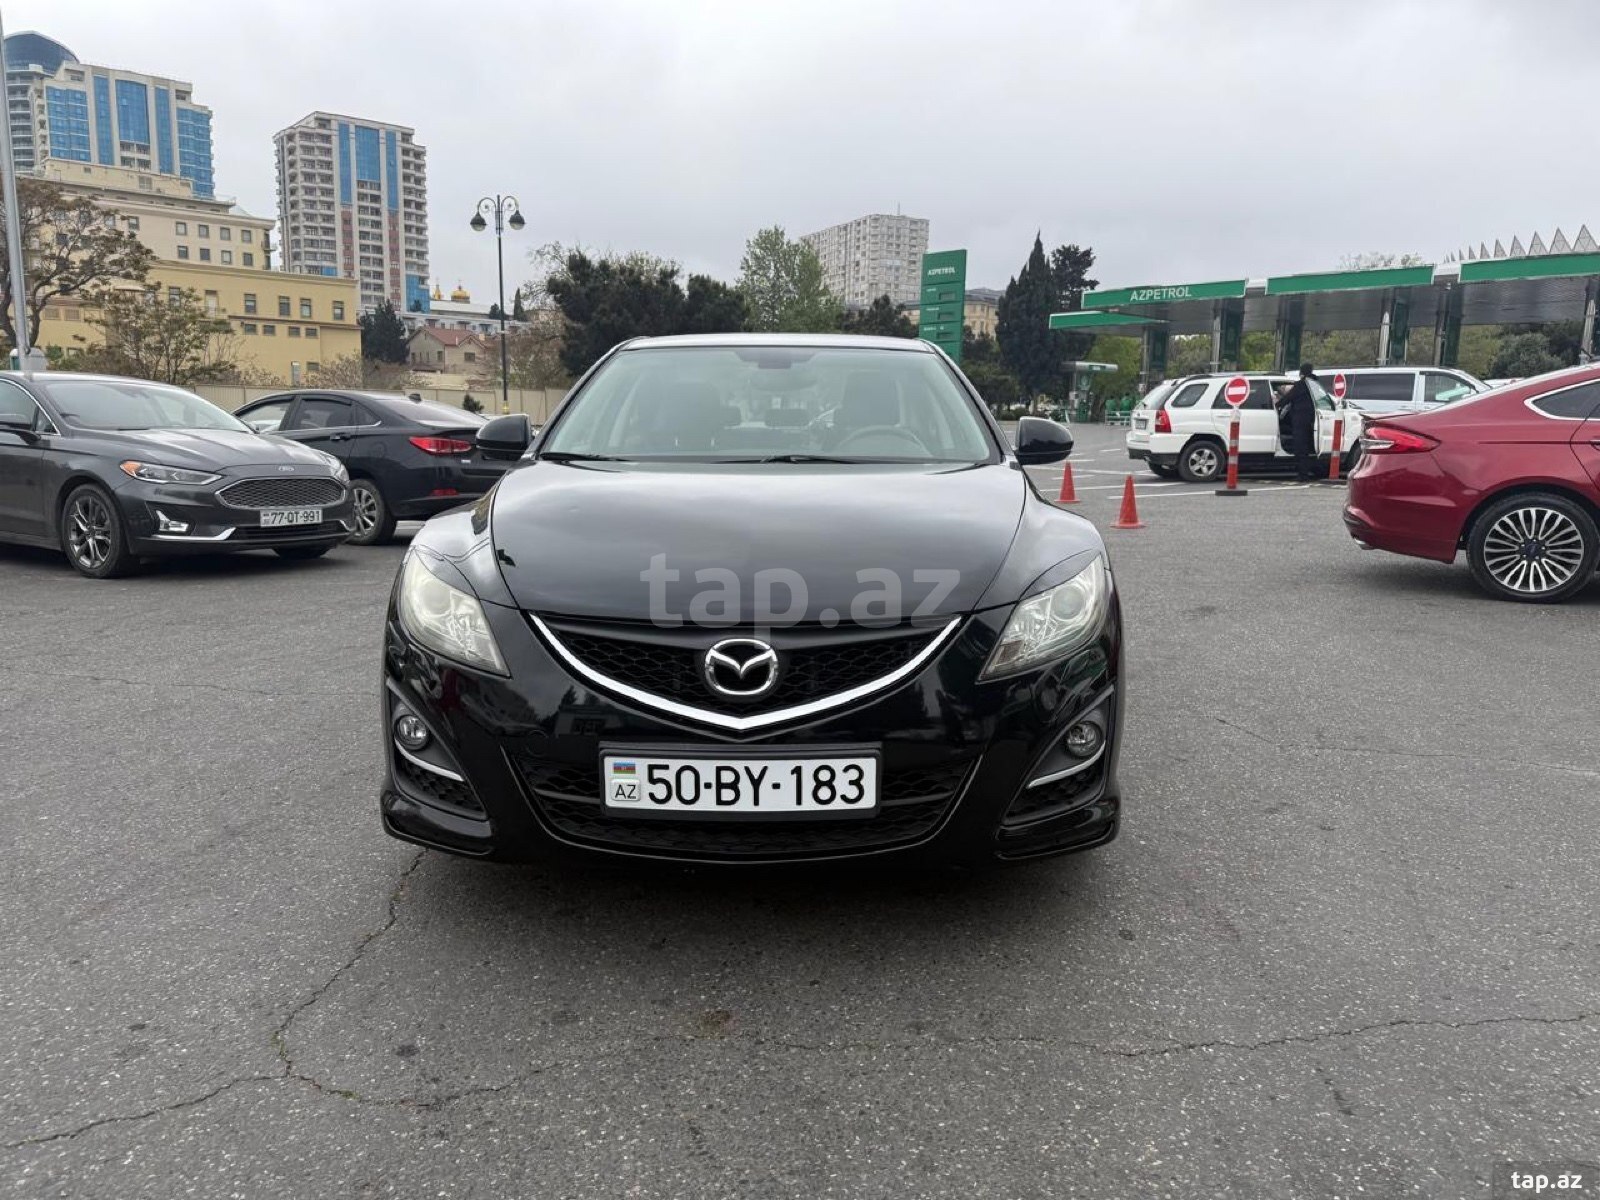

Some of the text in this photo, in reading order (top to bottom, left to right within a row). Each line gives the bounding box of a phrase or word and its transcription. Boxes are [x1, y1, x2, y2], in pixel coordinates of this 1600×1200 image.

[1130, 286, 1192, 301] AZPETROL
[614, 783, 637, 800] AZ
[647, 764, 865, 806] 50-BY-183
